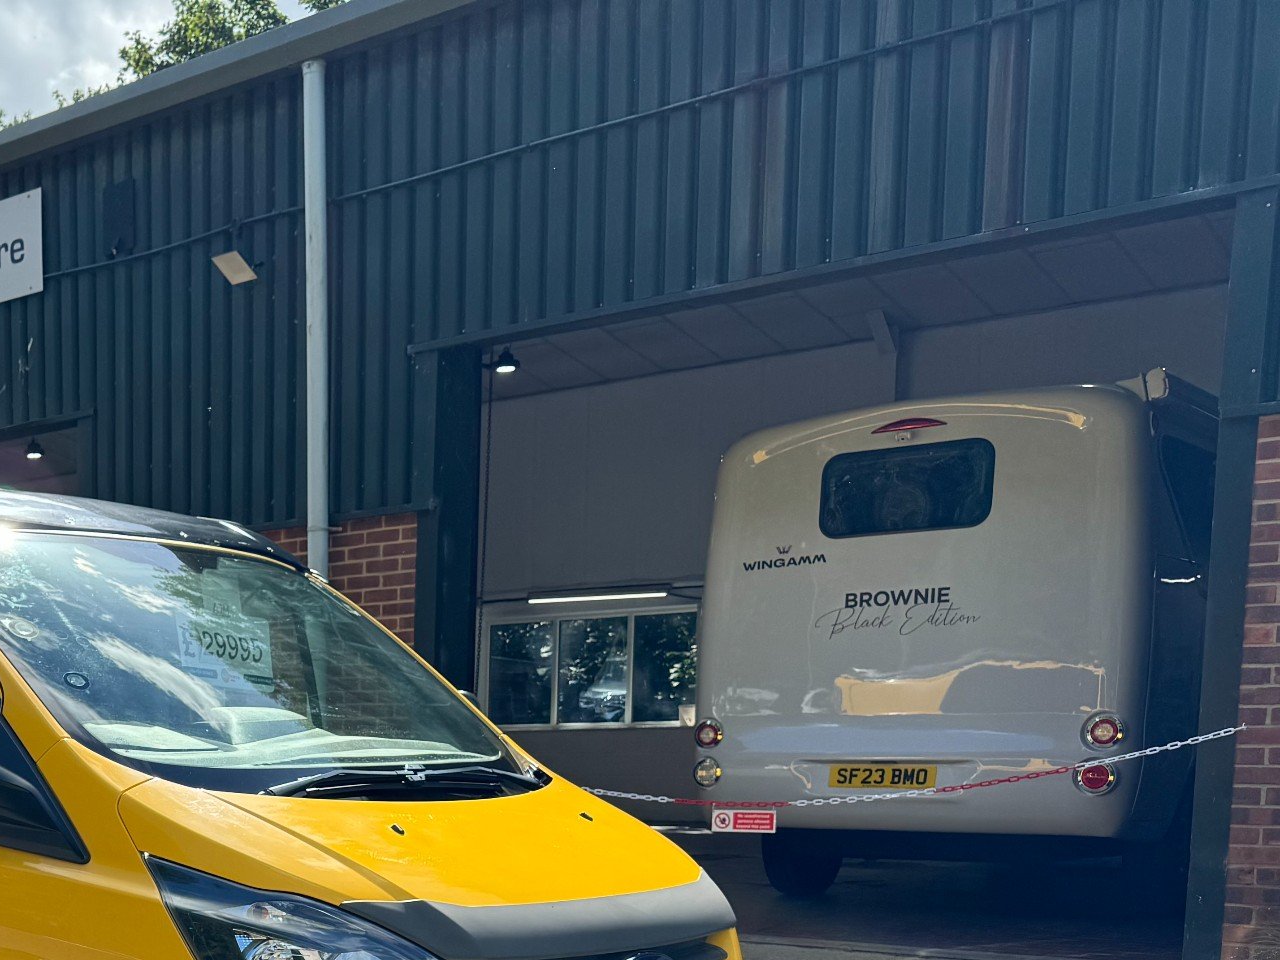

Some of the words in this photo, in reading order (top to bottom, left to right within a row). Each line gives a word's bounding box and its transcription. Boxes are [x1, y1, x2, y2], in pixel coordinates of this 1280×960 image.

[743, 553, 827, 571] WINGAMM
[844, 587, 951, 608] BROWNIE
[815, 605, 895, 640] Black
[899, 602, 982, 636] Edition
[836, 768, 886, 785] SF23
[889, 768, 928, 785] BMO
